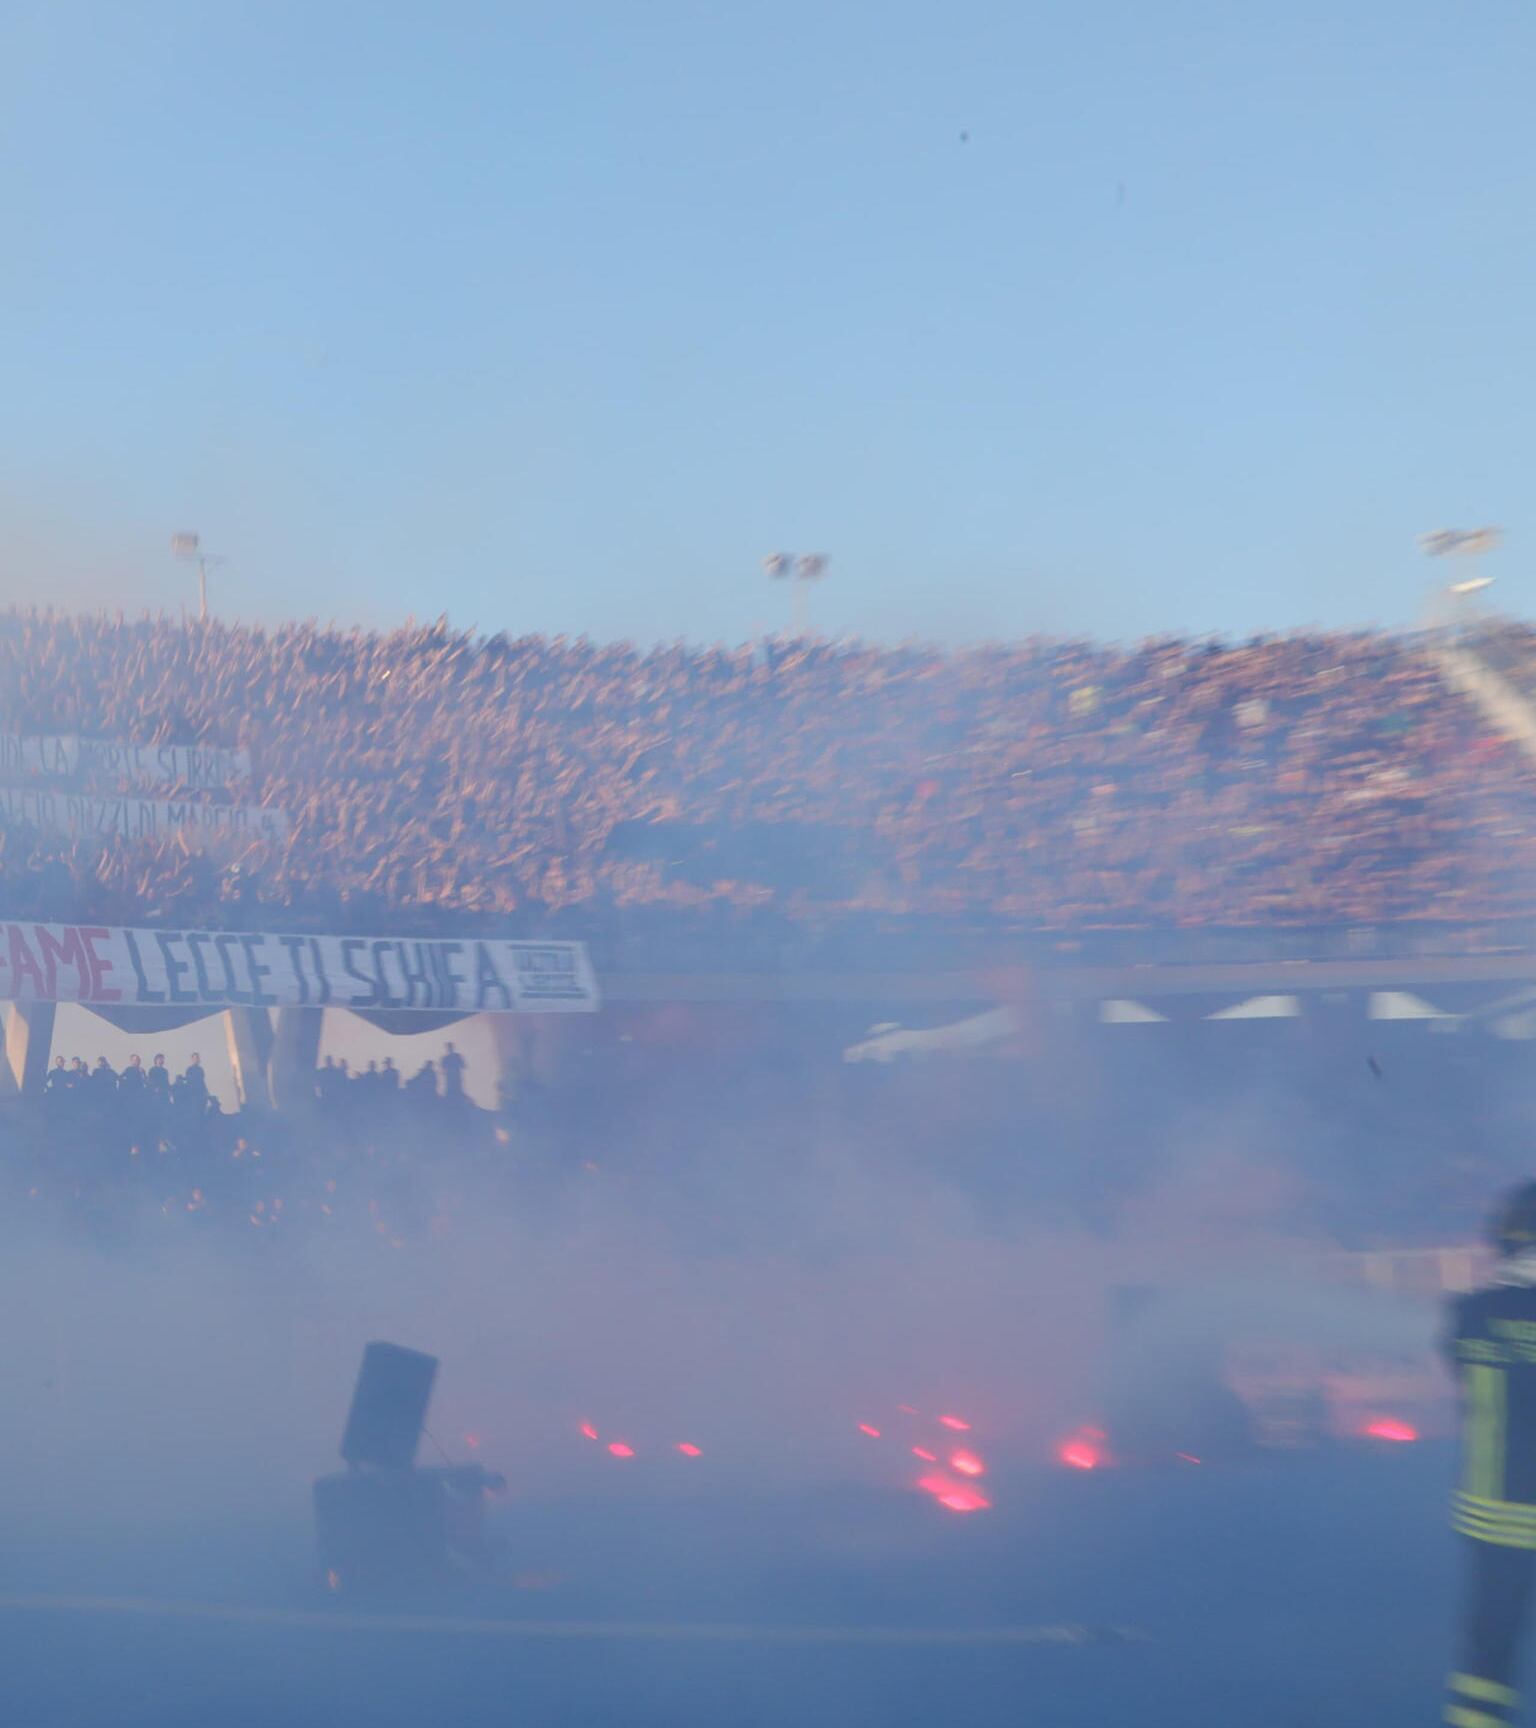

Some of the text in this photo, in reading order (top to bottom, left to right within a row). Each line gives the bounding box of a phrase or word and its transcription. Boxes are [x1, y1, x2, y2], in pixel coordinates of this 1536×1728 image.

[123, 929, 277, 1002] LECCE
[279, 936, 332, 1005] TI
[341, 939, 513, 1010] SCHIFA
